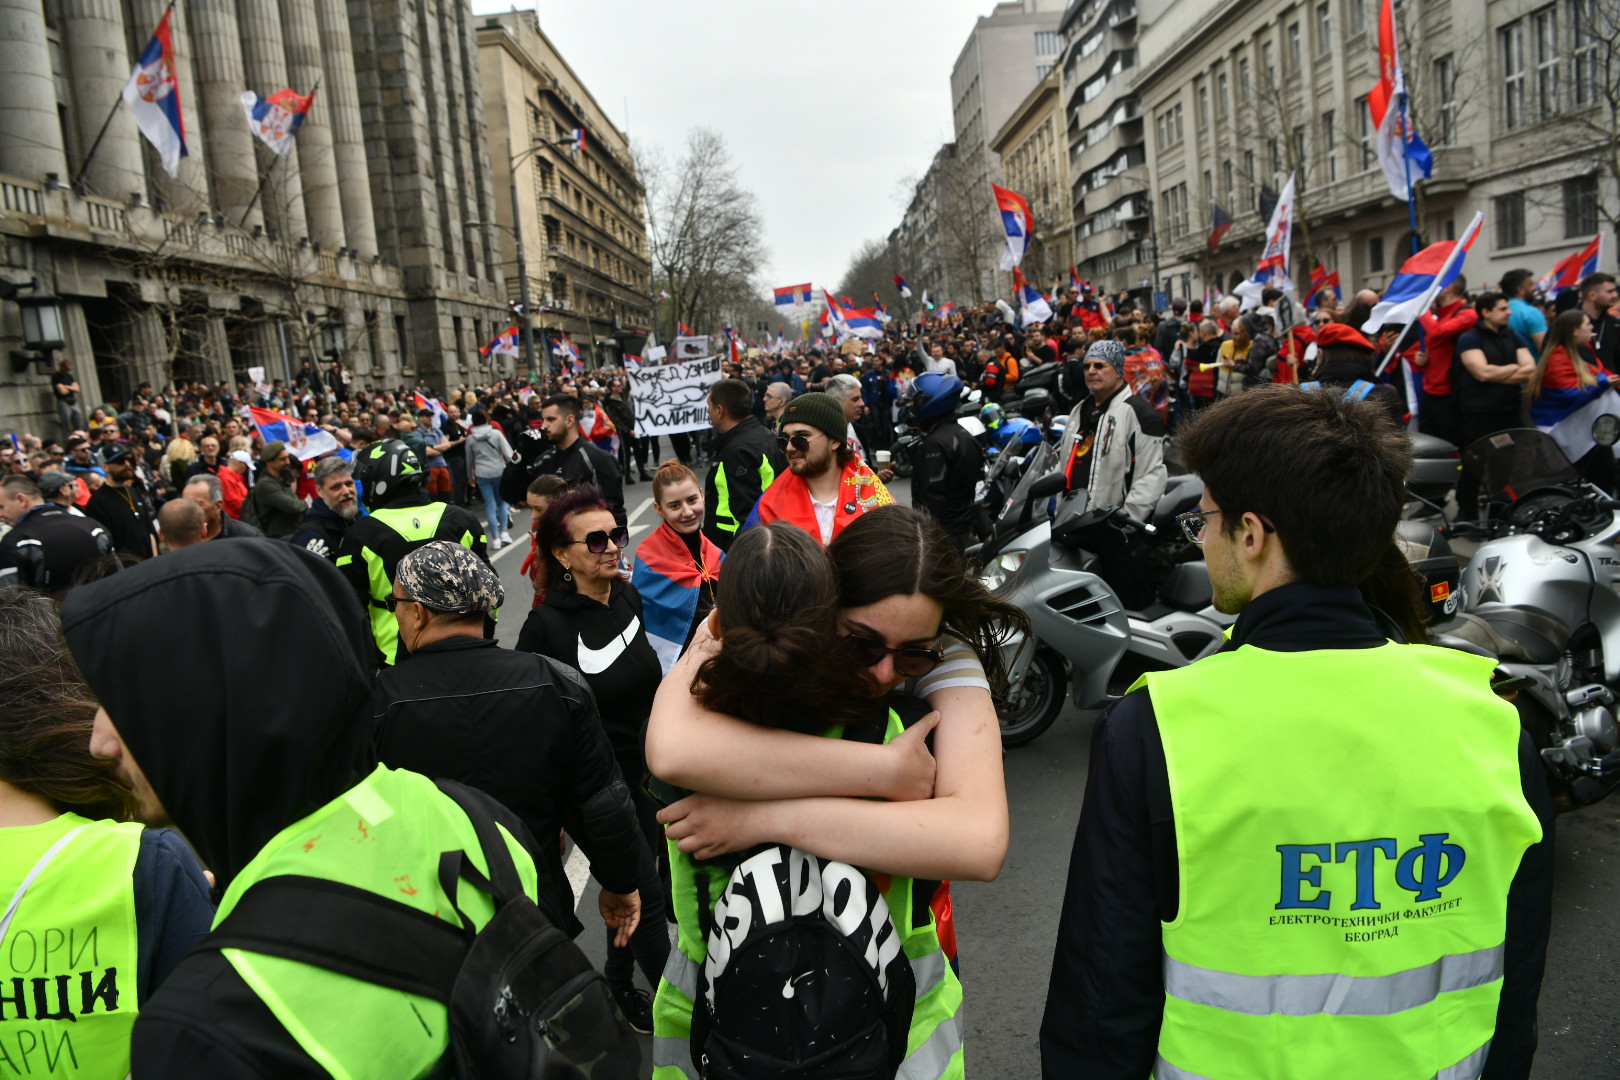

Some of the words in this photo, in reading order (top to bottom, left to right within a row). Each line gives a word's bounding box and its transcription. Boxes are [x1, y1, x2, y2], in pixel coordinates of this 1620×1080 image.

[1275, 833, 1466, 911] ЕТФ
[1269, 911, 1400, 928] ЕЛЕКТРОТЕХНИЧКИ
[1403, 897, 1463, 920] ФАКУЛТЕТ
[10, 926, 99, 975] ОРИ
[1345, 925, 1399, 943] БЕОГРАД
